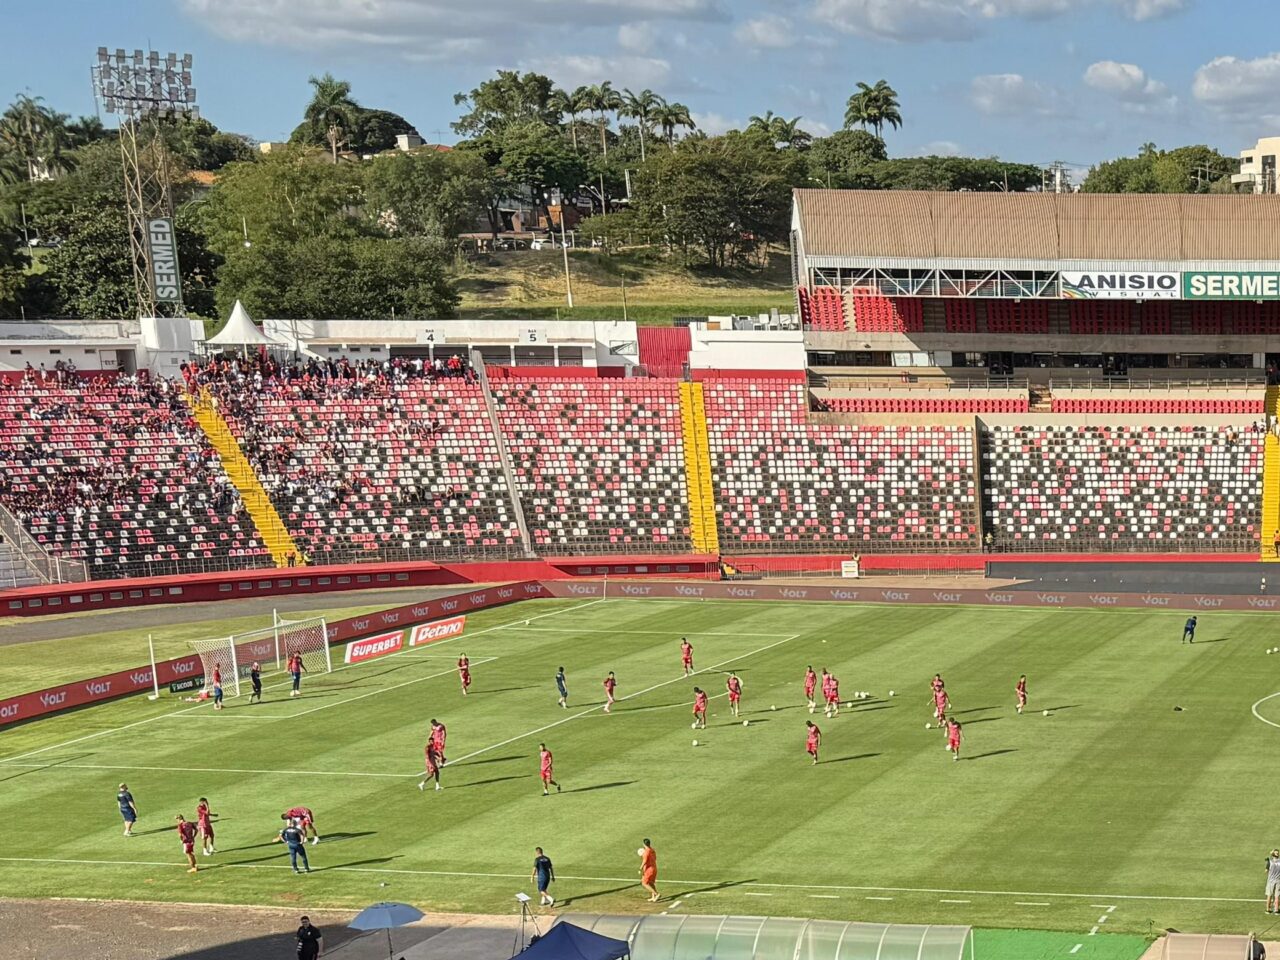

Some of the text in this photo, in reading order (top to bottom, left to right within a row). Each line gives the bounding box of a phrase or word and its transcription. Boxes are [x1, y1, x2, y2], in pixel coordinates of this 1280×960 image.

[149, 219, 178, 299] SERMED
[1077, 273, 1177, 290] ANISIO
[427, 333, 434, 342] 4
[529, 333, 537, 342] 5
[497, 588, 514, 598] VOLT
[524, 583, 542, 594] VOLT
[567, 584, 598, 594] VOLT
[621, 585, 650, 594] VOLT
[675, 585, 704, 596] VOLT
[727, 587, 756, 597] VOLT
[779, 588, 808, 598] VOLT
[469, 594, 486, 605] VOLT
[831, 589, 859, 600] VOLT
[882, 590, 910, 600] VOLT
[933, 591, 962, 602] VOLT
[985, 593, 1014, 602] VOLT
[1037, 593, 1066, 604] VOLT
[1089, 594, 1118, 604] VOLT
[440, 600, 458, 611] VOLT
[1141, 596, 1170, 605] VOLT
[1194, 597, 1224, 606] VOLT
[1248, 597, 1277, 607] VOLT
[411, 606, 430, 617] VOLT
[381, 612, 400, 624] VOLT
[351, 619, 370, 632] VOLT
[417, 620, 462, 642] Betano
[351, 634, 402, 657] SUPERBET
[172, 661, 195, 674] VOLT
[86, 681, 111, 695] VOLT
[40, 691, 67, 708] VOLT
